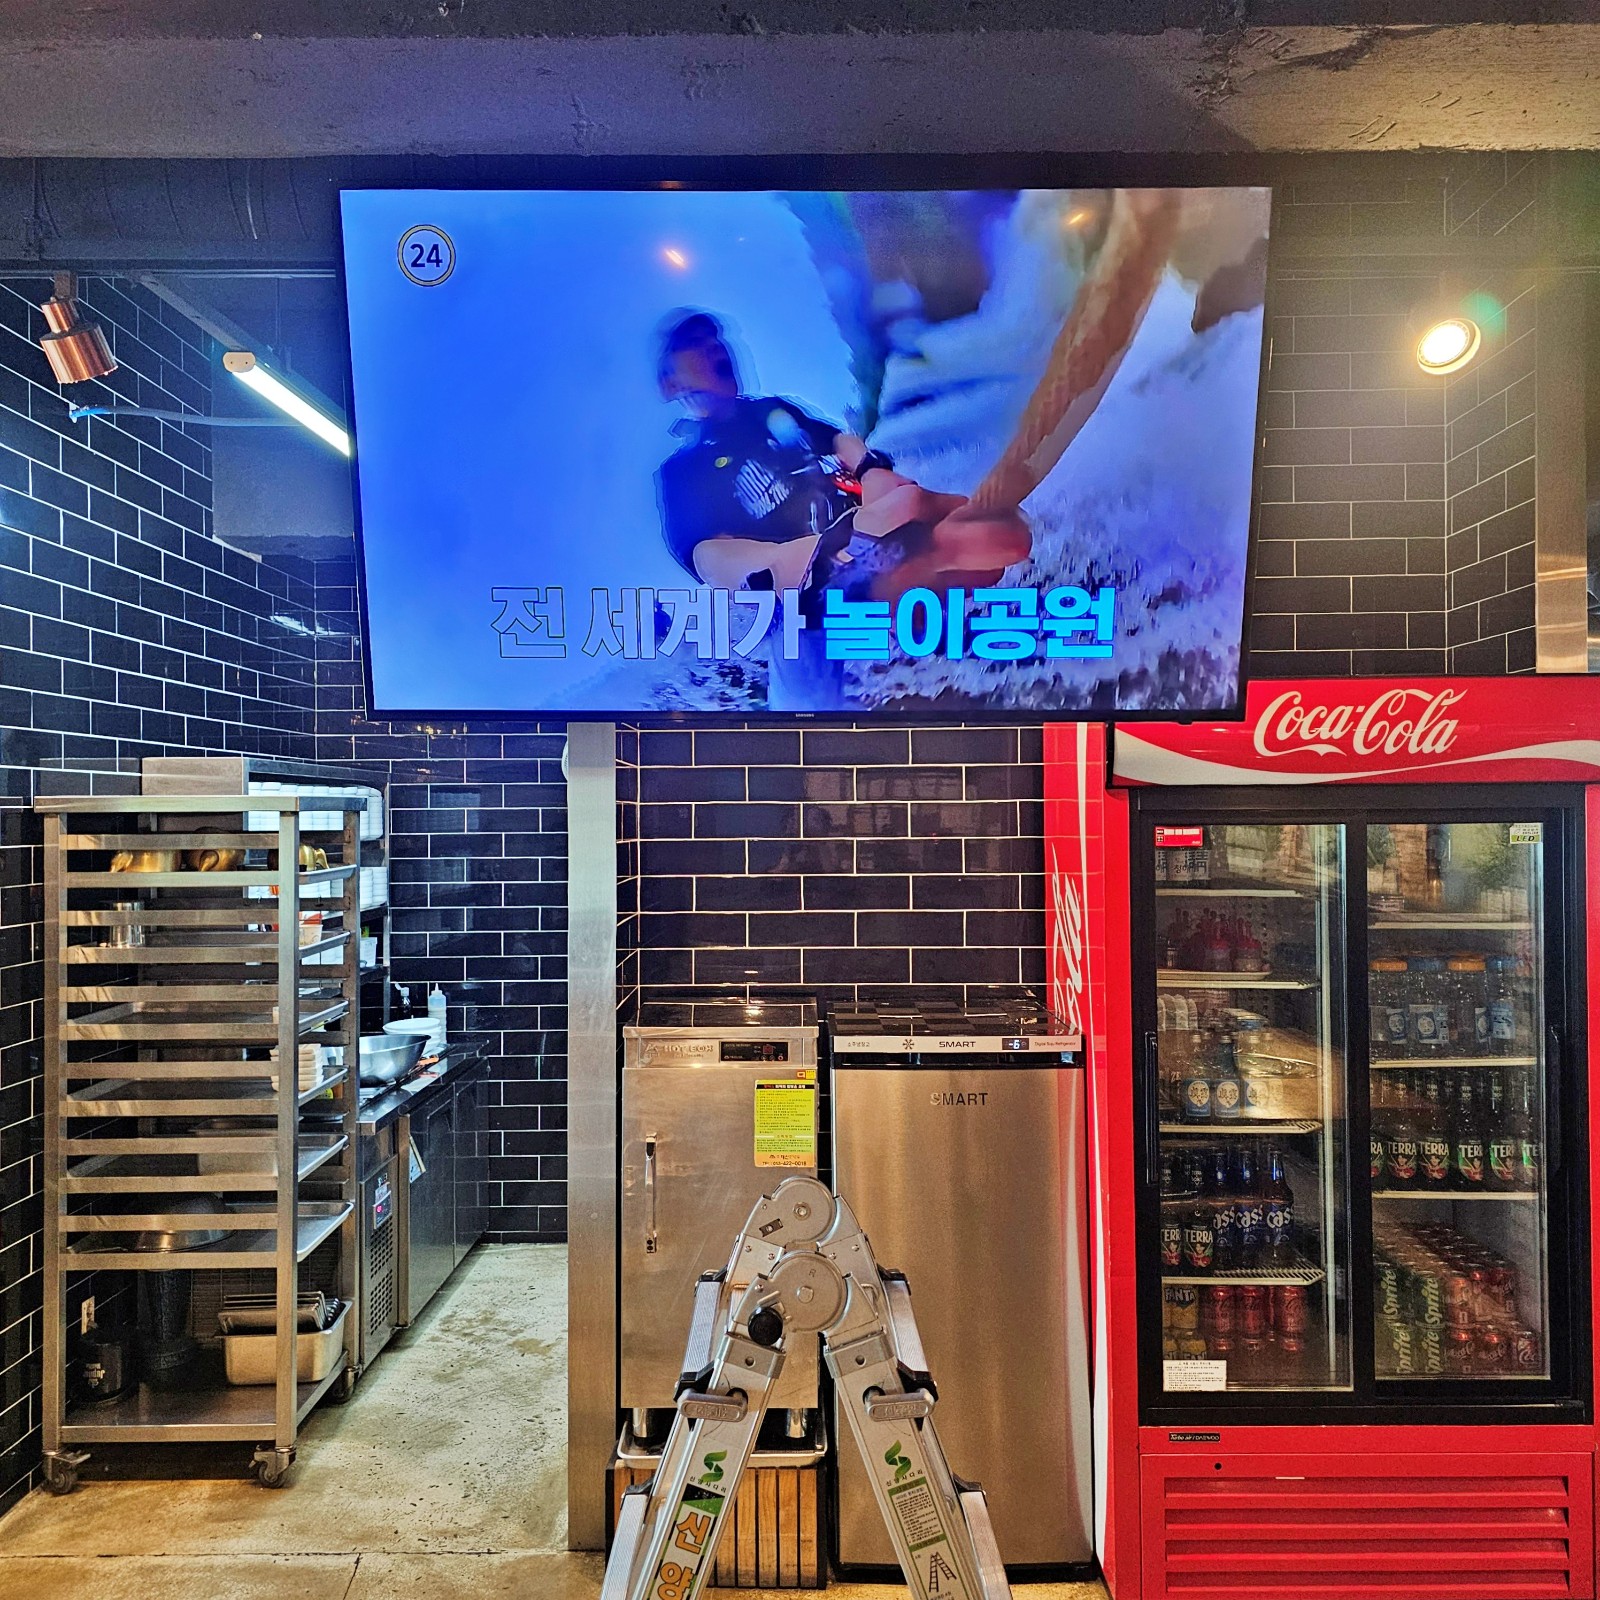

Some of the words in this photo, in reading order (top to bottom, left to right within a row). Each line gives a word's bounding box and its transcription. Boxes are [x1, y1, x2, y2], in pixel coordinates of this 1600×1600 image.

[410, 243, 444, 268] 24
[490, 586, 567, 658] 전
[581, 587, 807, 660] 세계가
[823, 585, 1117, 661] 놀이공원
[1253, 688, 1468, 757] Coca-Cola
[930, 1092, 988, 1106] SMART
[1387, 1142, 1417, 1155] TERRA
[1419, 1142, 1450, 1156] TERRA
[1184, 1229, 1213, 1243] TERRA
[1421, 1277, 1443, 1325] Sprite
